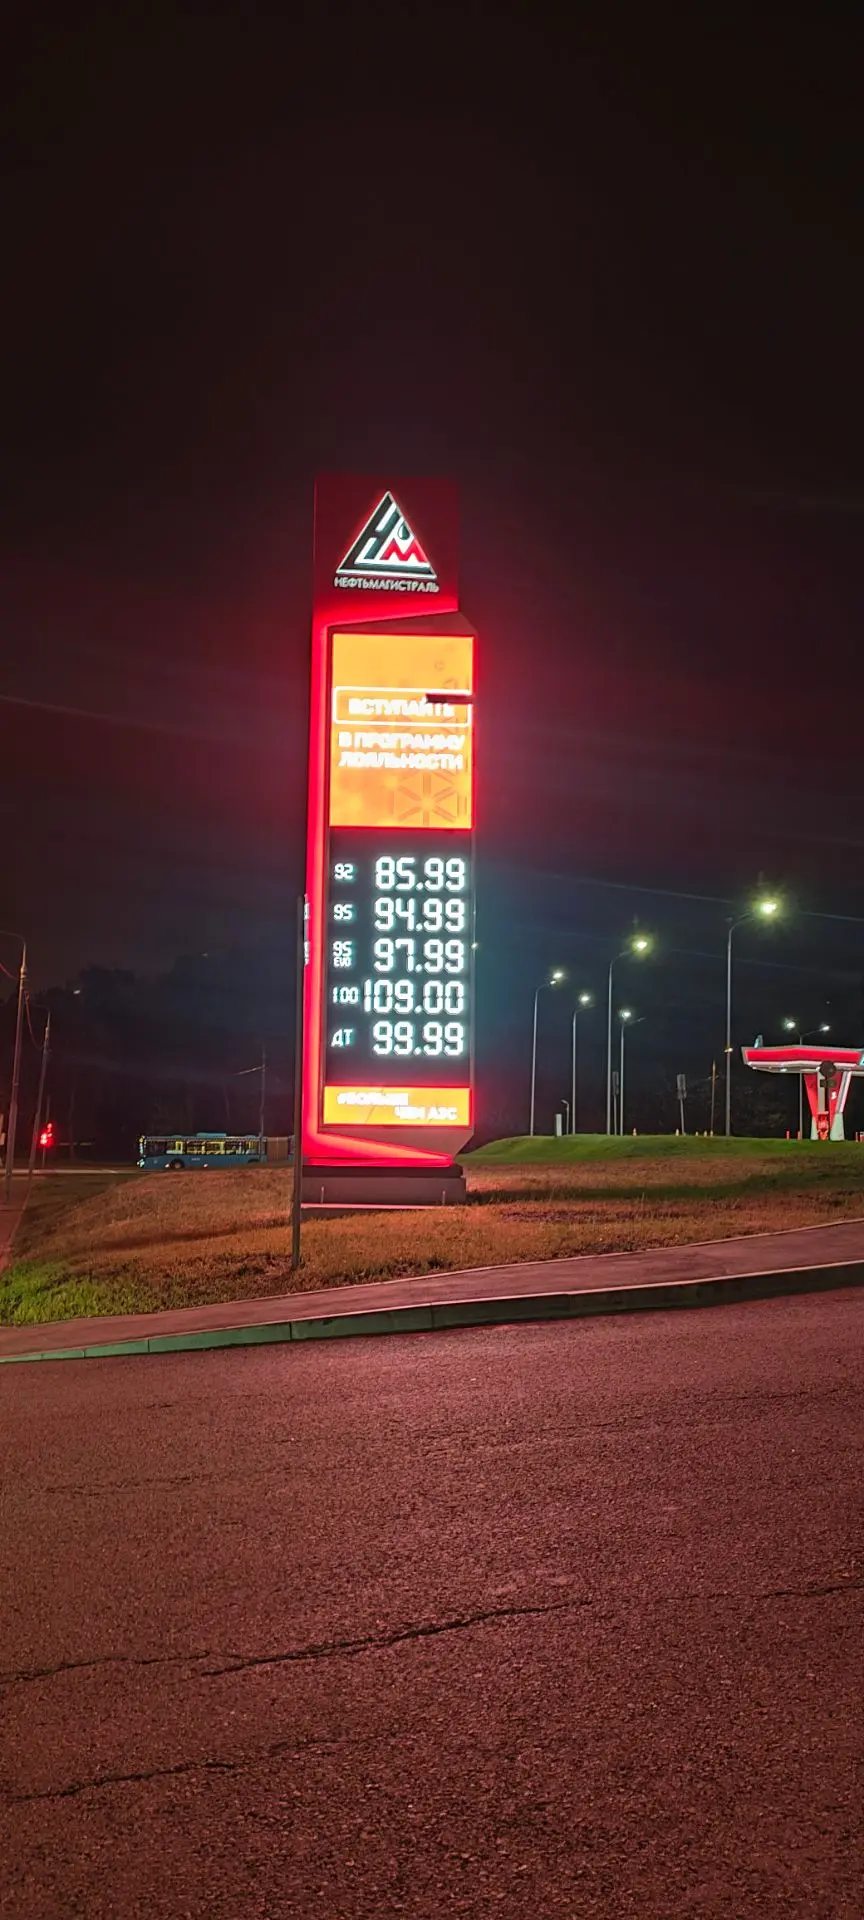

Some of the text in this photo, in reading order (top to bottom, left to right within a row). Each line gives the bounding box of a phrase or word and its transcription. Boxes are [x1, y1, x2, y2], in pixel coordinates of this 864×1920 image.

[334, 576, 440, 593] НЕФТЬМАГИСТРАЛЬ
[334, 856, 465, 892] 92 85.99
[333, 897, 465, 932] 95 94.99
[332, 938, 464, 973] 95 97.99
[332, 979, 464, 1015] 100 109.00
[331, 1021, 463, 1056] ДТ 99.99
